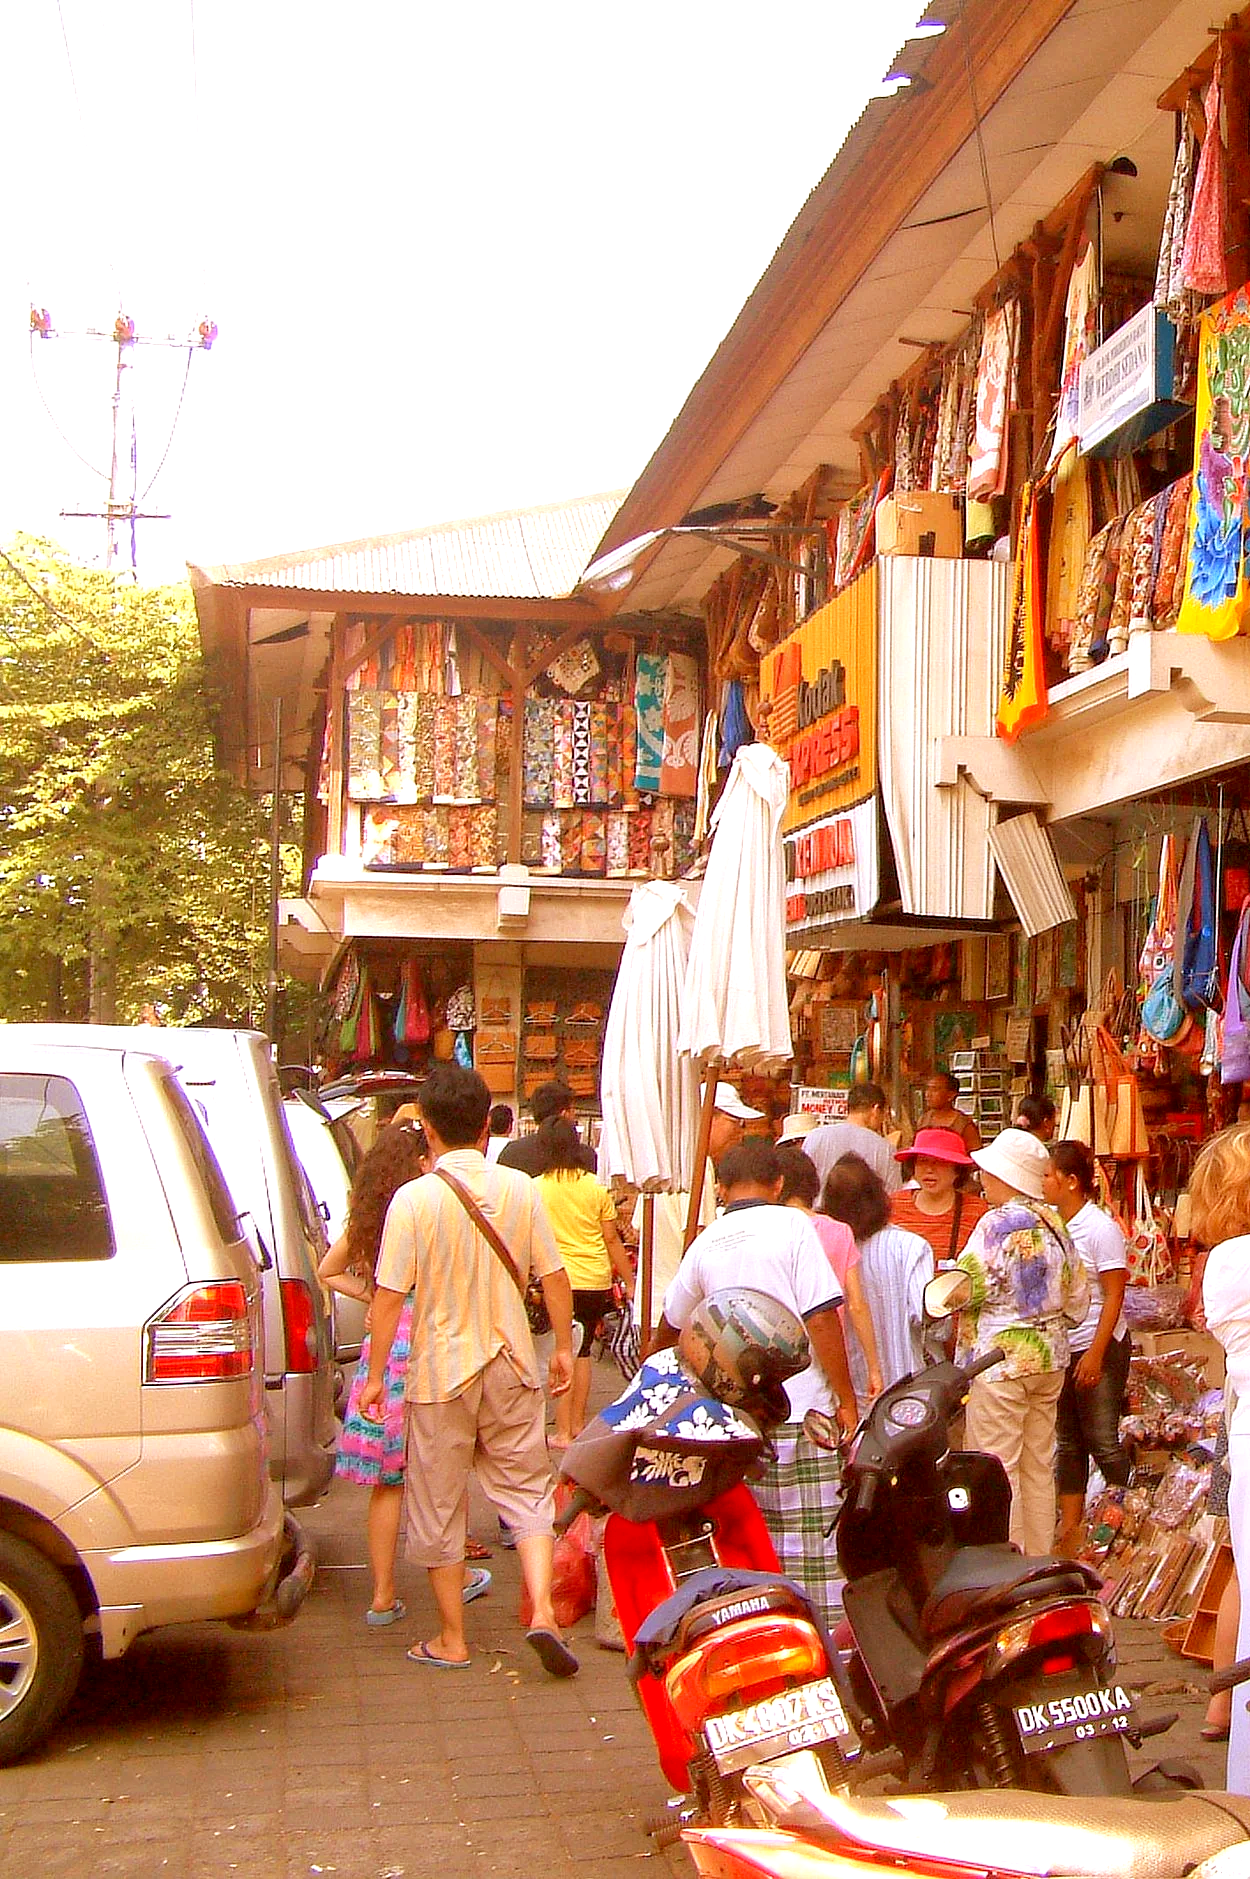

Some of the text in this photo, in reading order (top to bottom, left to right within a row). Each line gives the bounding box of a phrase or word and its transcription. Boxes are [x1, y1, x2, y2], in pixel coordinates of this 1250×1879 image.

[797, 659, 847, 731] Kodak
[783, 705, 860, 790] XPRESS
[802, 1103, 833, 1114] MONEY
[712, 1596, 770, 1625] YAMAHA
